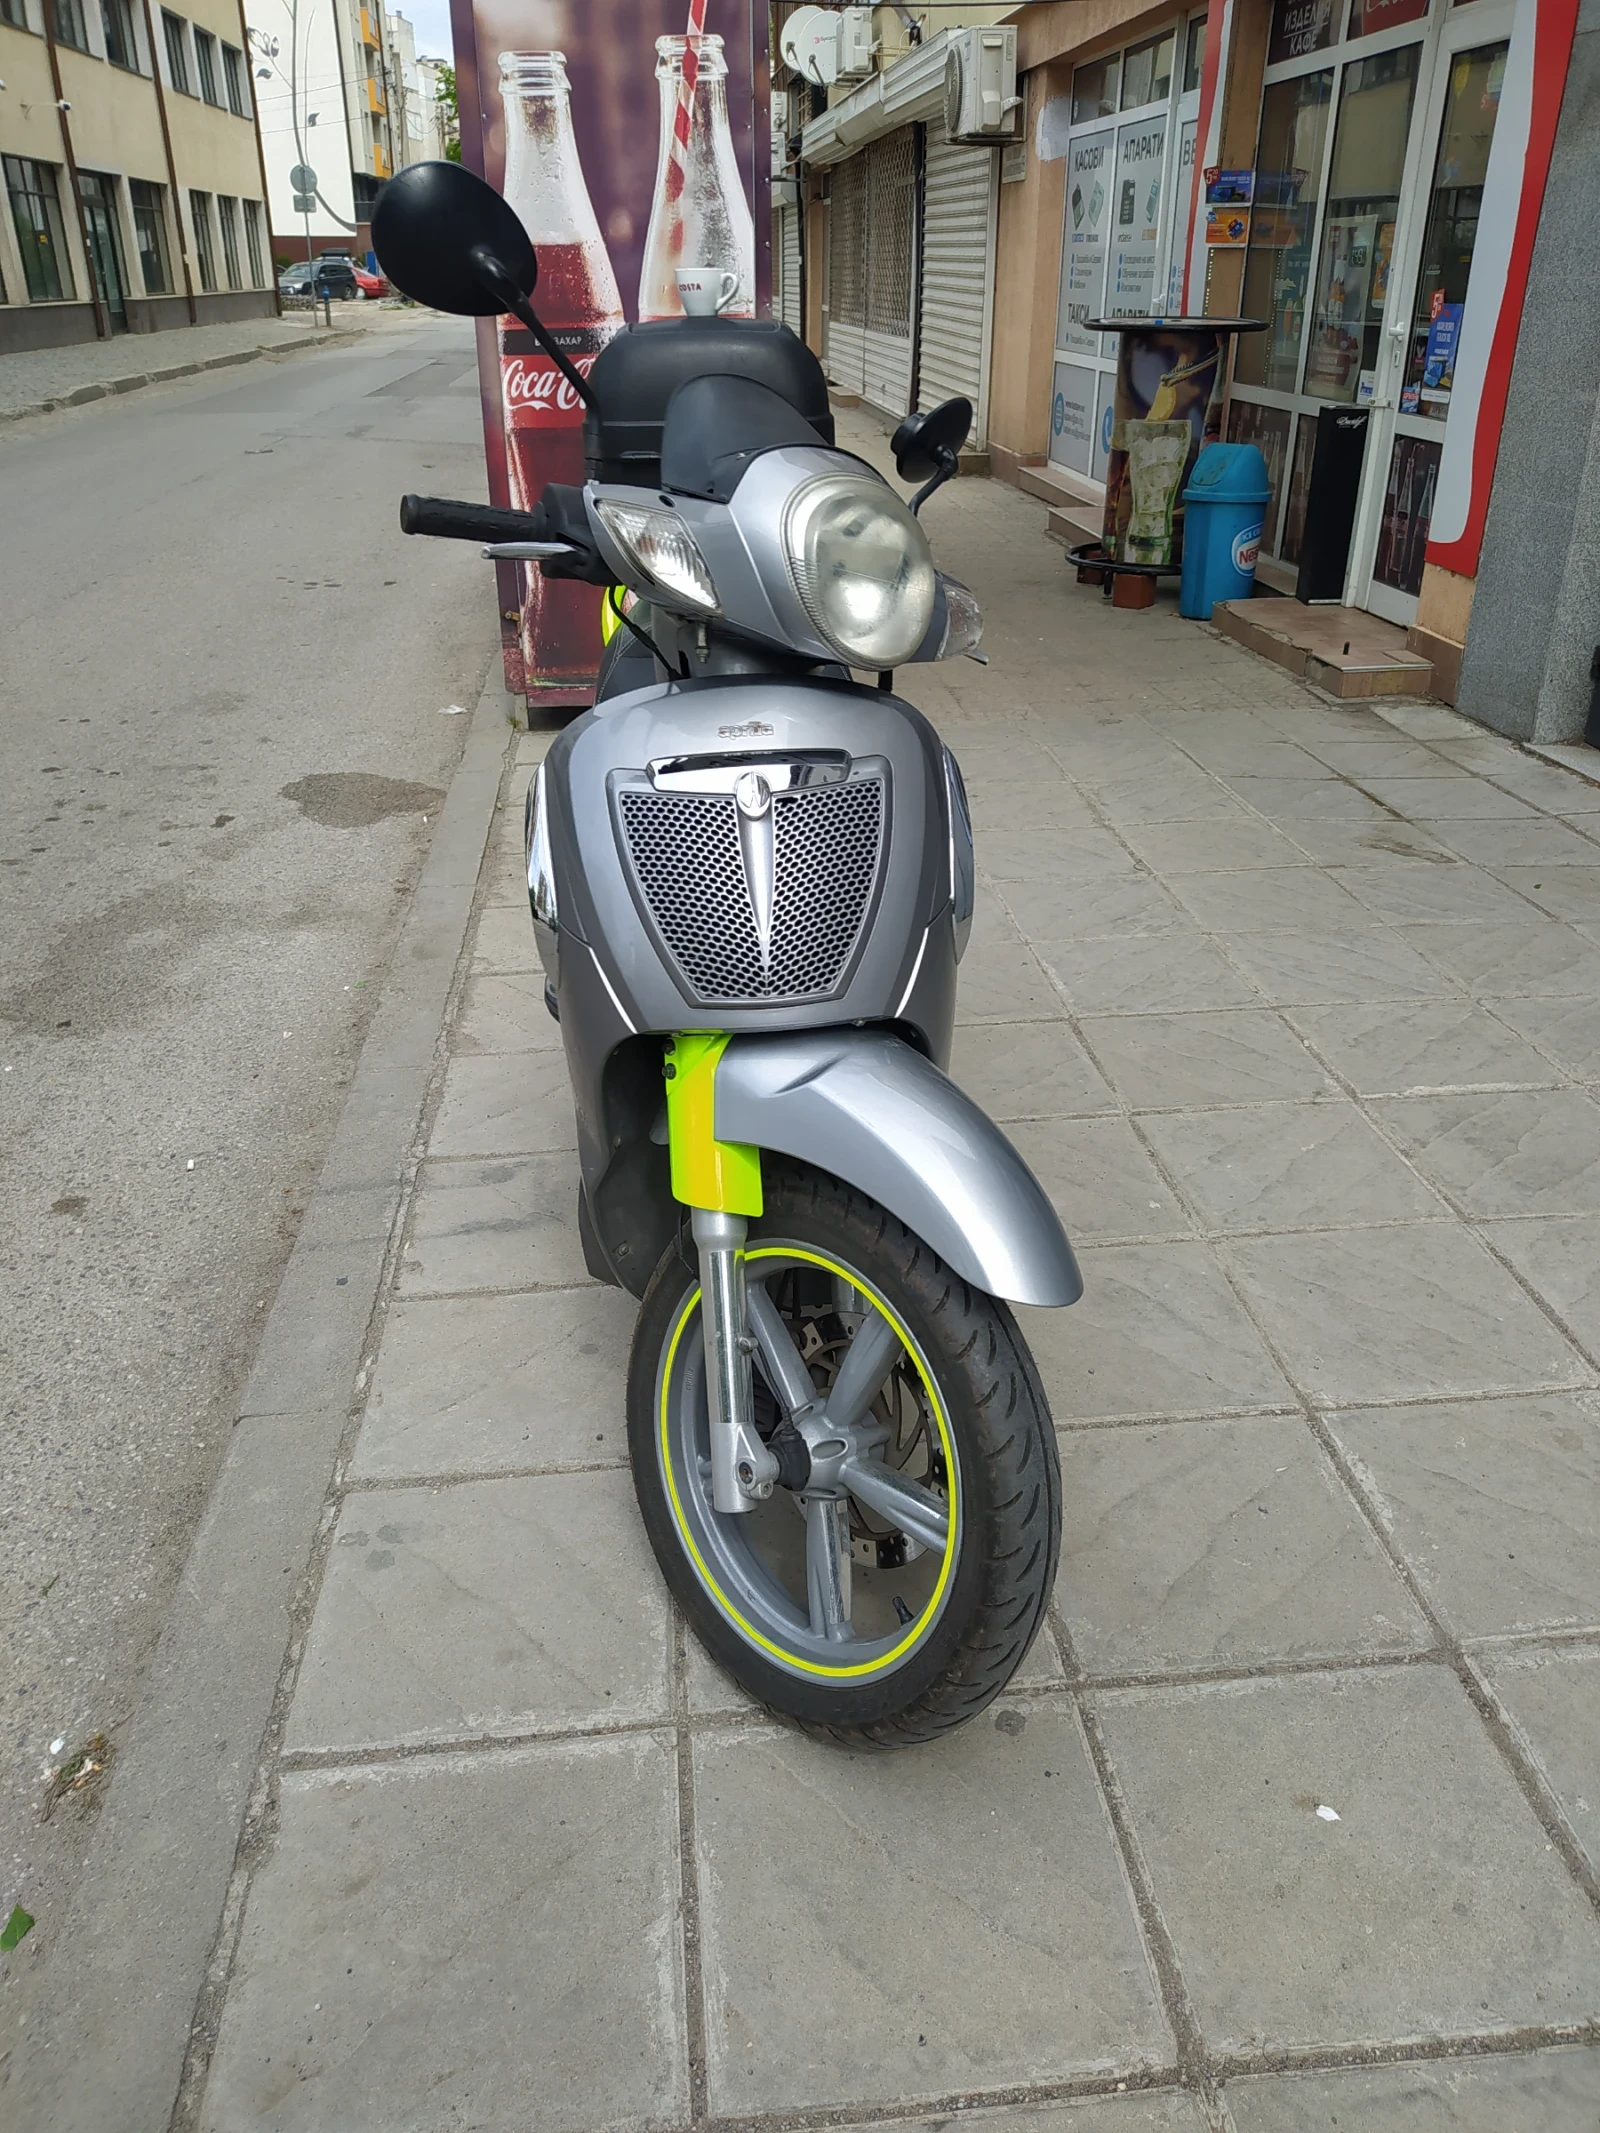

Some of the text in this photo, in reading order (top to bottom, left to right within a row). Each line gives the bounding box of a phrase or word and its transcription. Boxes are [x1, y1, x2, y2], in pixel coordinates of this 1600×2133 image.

[1284, 1, 1331, 31] ИЗДЕЛИЯ
[1290, 30, 1317, 56] КАФЕ
[1074, 146, 1105, 172] КАСОВИ
[1123, 132, 1164, 164] АПАРАТИ
[679, 283, 702, 292] COSTA
[1068, 303, 1090, 326] ТАКСИ
[502, 357, 597, 411] Coca-C
[1239, 544, 1260, 564] Nes
[718, 721, 774, 740] aprilia
